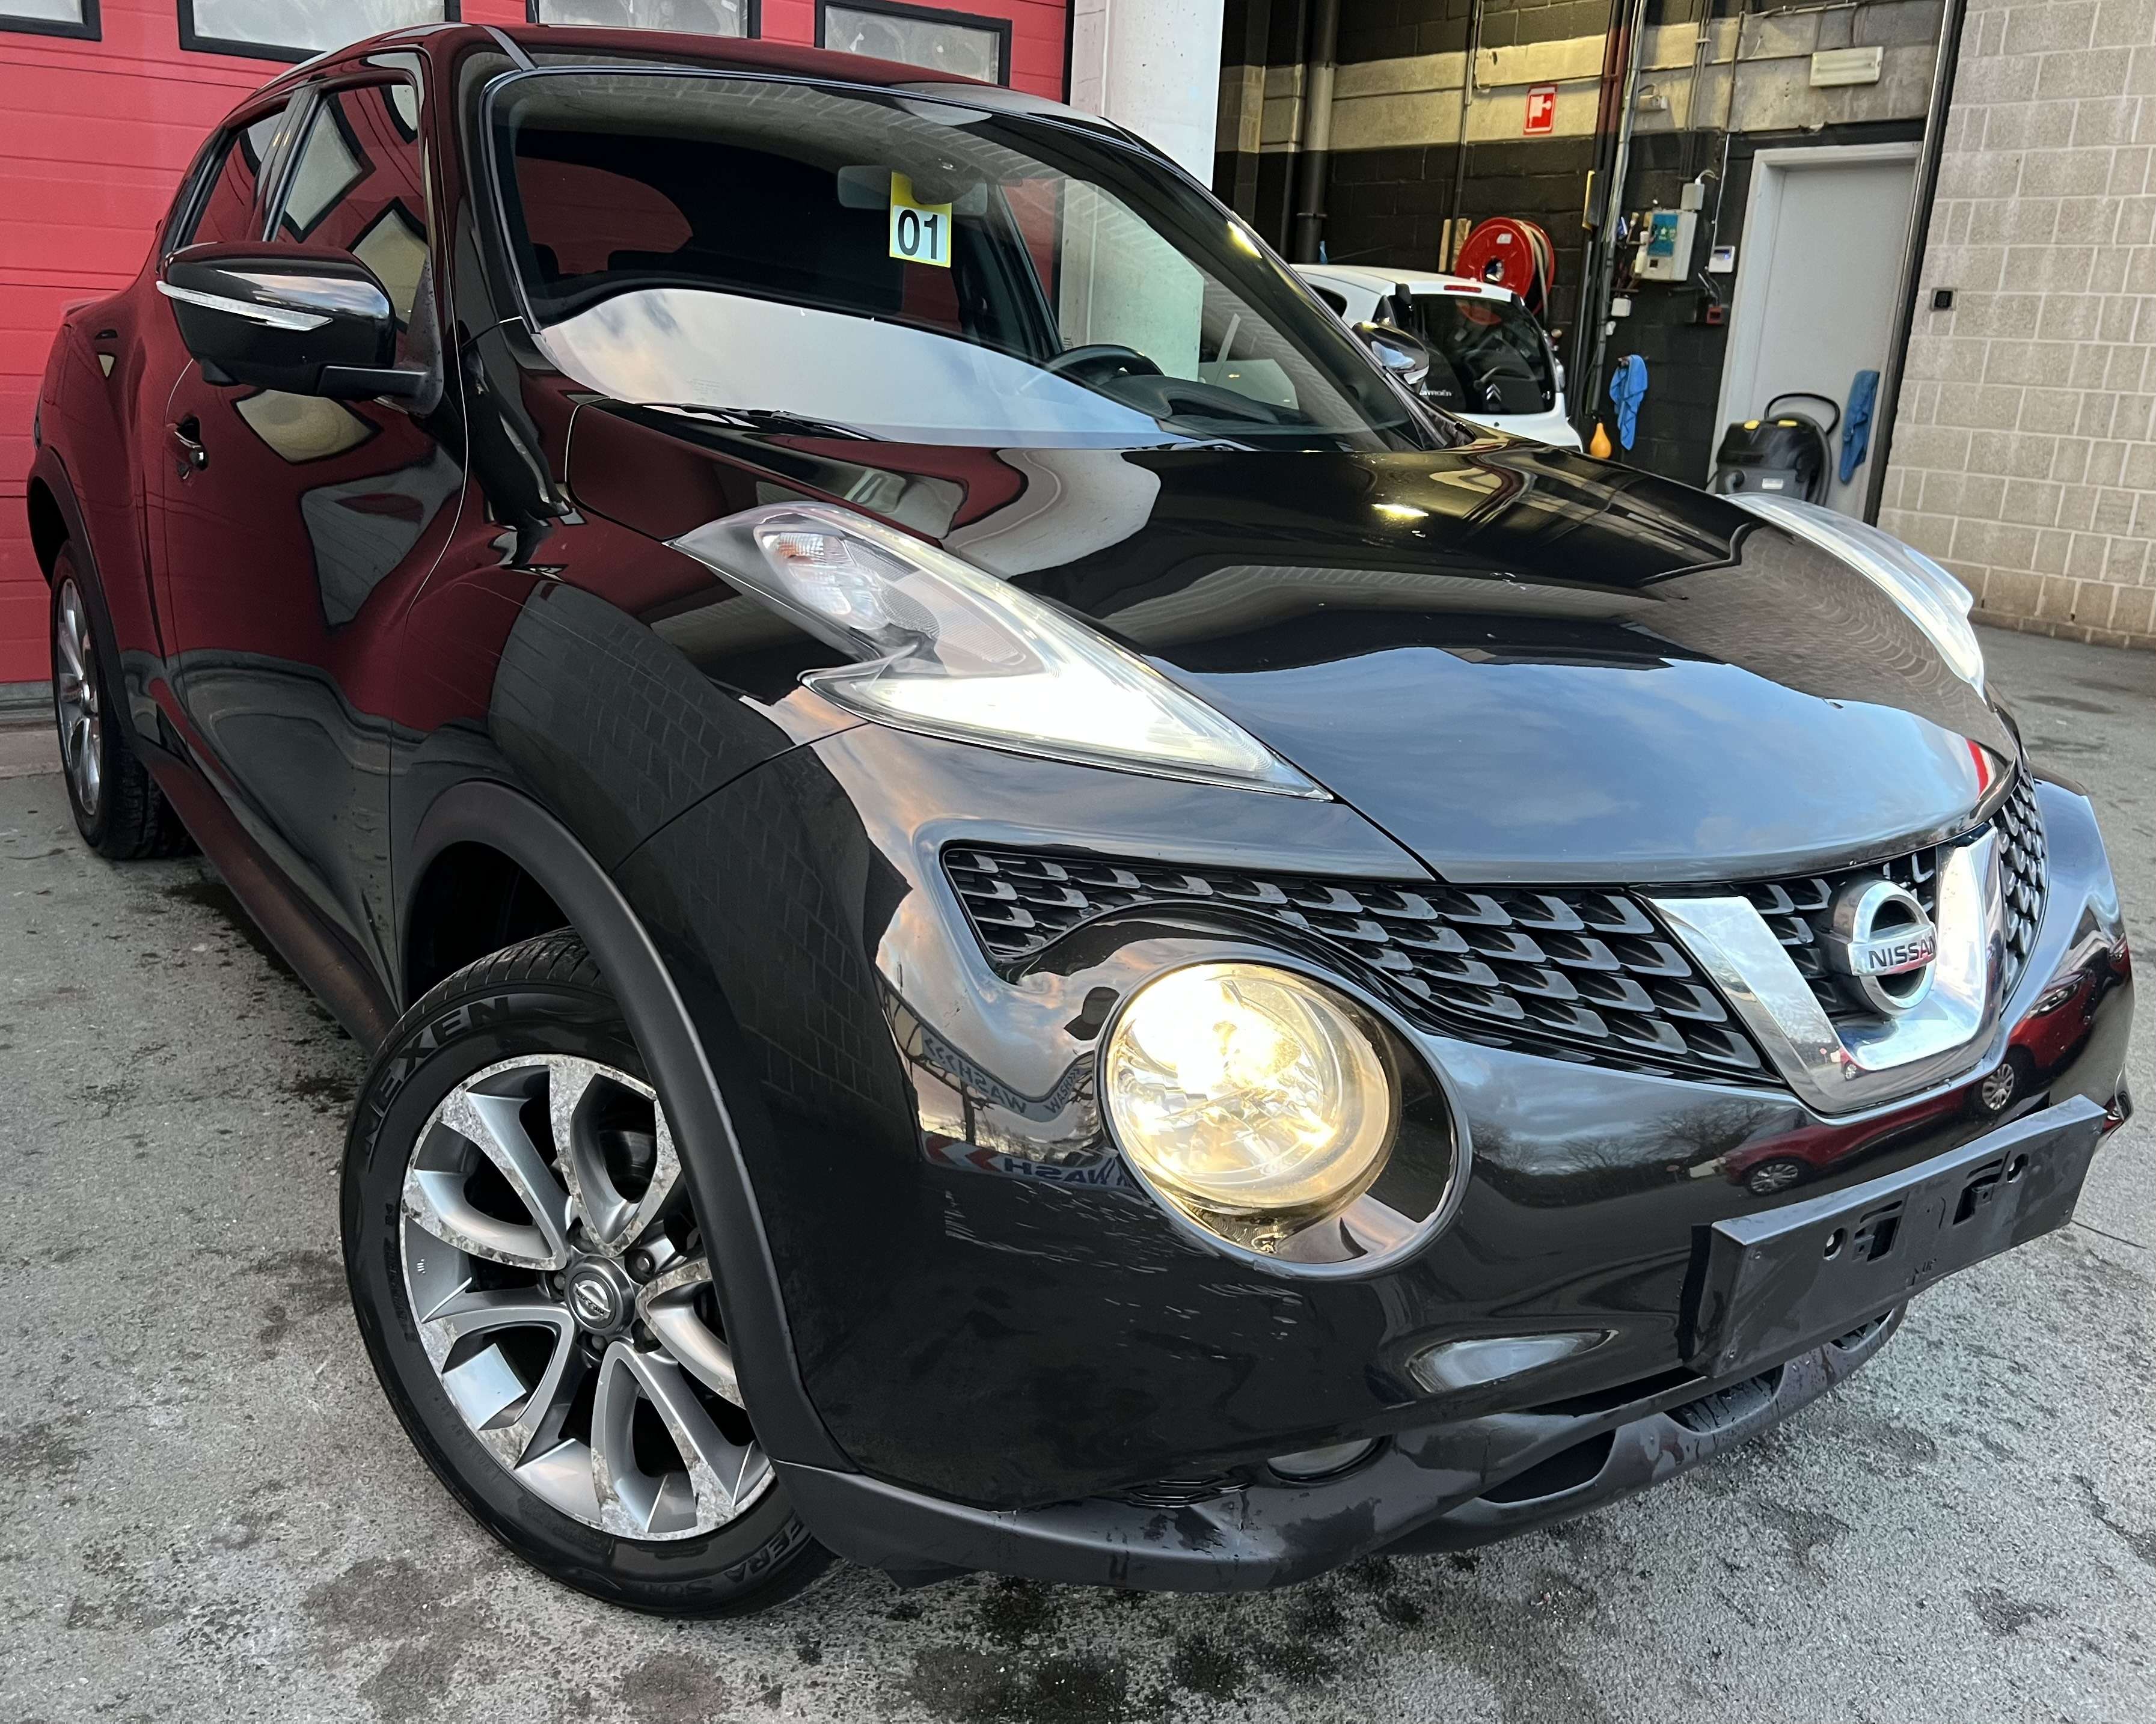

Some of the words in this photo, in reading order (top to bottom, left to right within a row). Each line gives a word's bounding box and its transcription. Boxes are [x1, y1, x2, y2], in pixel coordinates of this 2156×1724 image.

[898, 209, 938, 259] 01
[1869, 935, 1936, 968] NISSAN
[364, 997, 509, 1157] NEXEN
